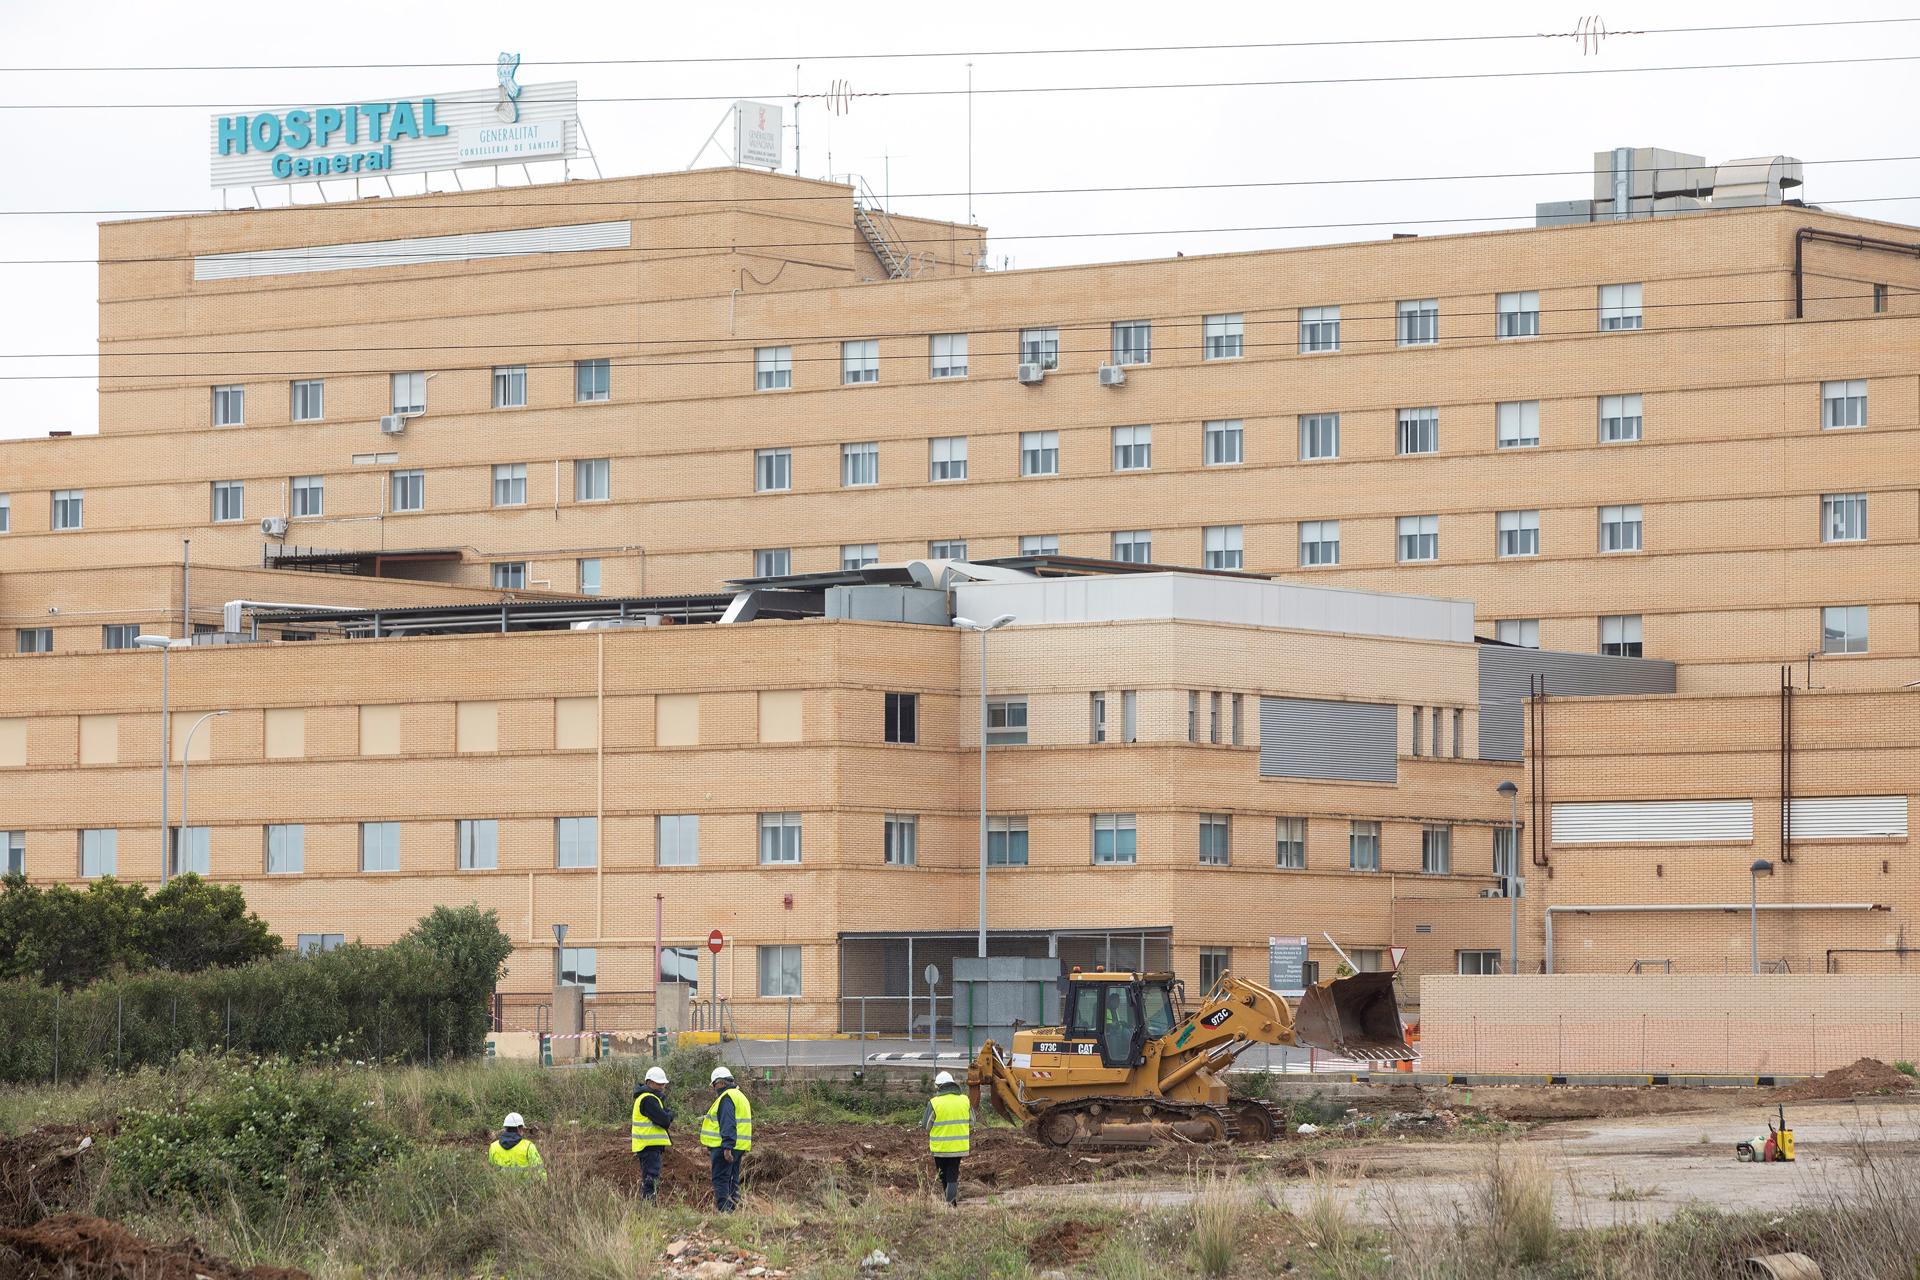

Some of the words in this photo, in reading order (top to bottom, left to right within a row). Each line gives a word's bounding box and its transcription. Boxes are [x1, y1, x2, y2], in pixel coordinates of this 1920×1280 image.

[218, 98, 449, 155] HOSPITAL
[480, 126, 539, 143] GENERALITAT
[459, 145, 509, 157] CONSELLERIA
[514, 143, 523, 152] DE
[528, 140, 559, 150] SANITAT
[271, 144, 392, 179] General
[1211, 1008, 1229, 1026] 973C
[1040, 1042, 1057, 1052] 973C
[1078, 1043, 1095, 1055] CAT
